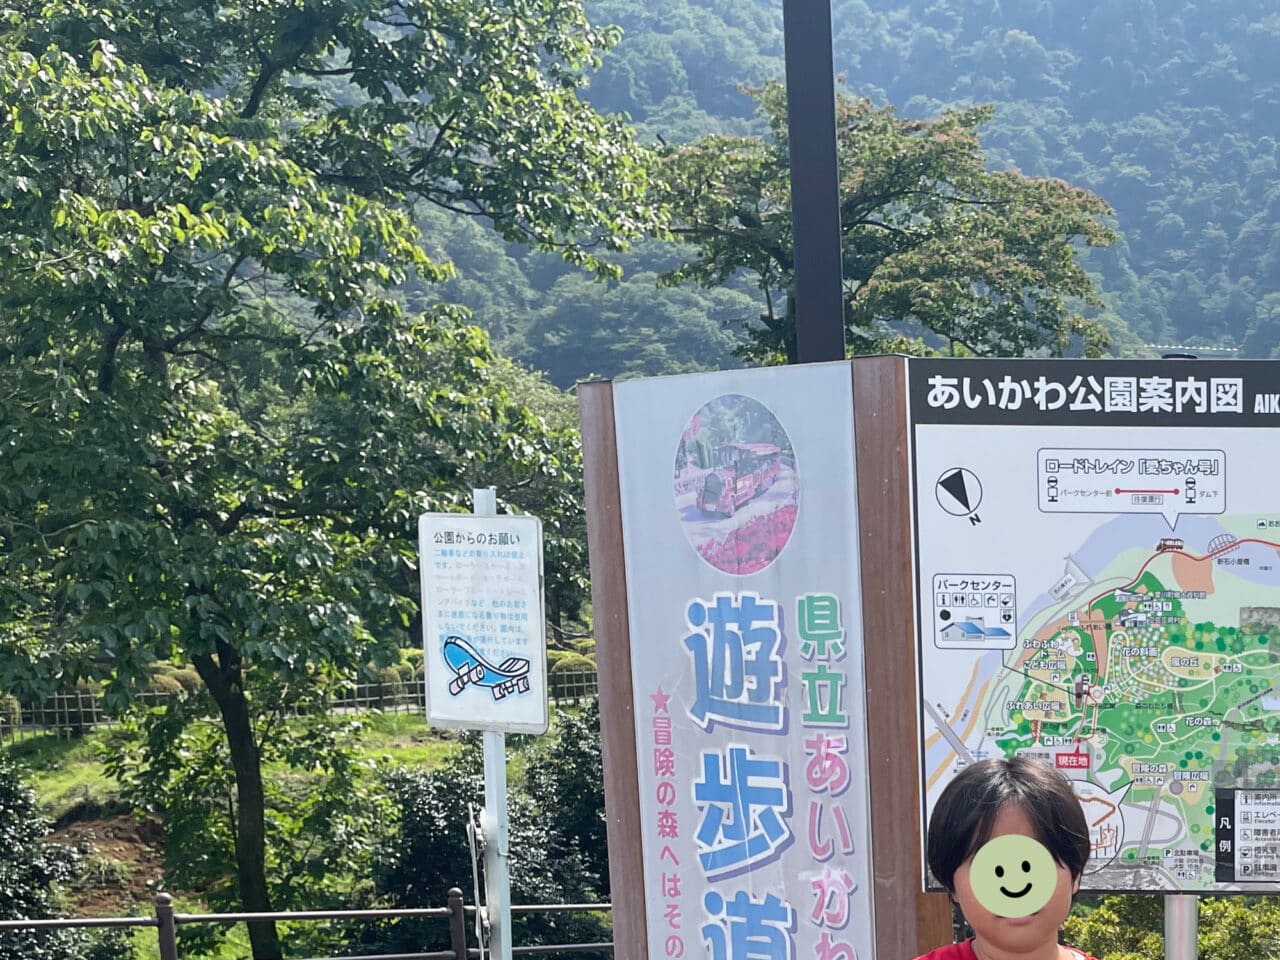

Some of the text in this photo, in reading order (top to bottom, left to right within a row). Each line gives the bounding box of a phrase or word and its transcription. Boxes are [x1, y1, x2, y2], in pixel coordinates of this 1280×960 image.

[926, 375, 1244, 414] あいかわ公園案内図
[970, 514, 981, 526] N
[433, 531, 521, 546] 公園からのお願い
[1058, 756, 1088, 766] 現在地
